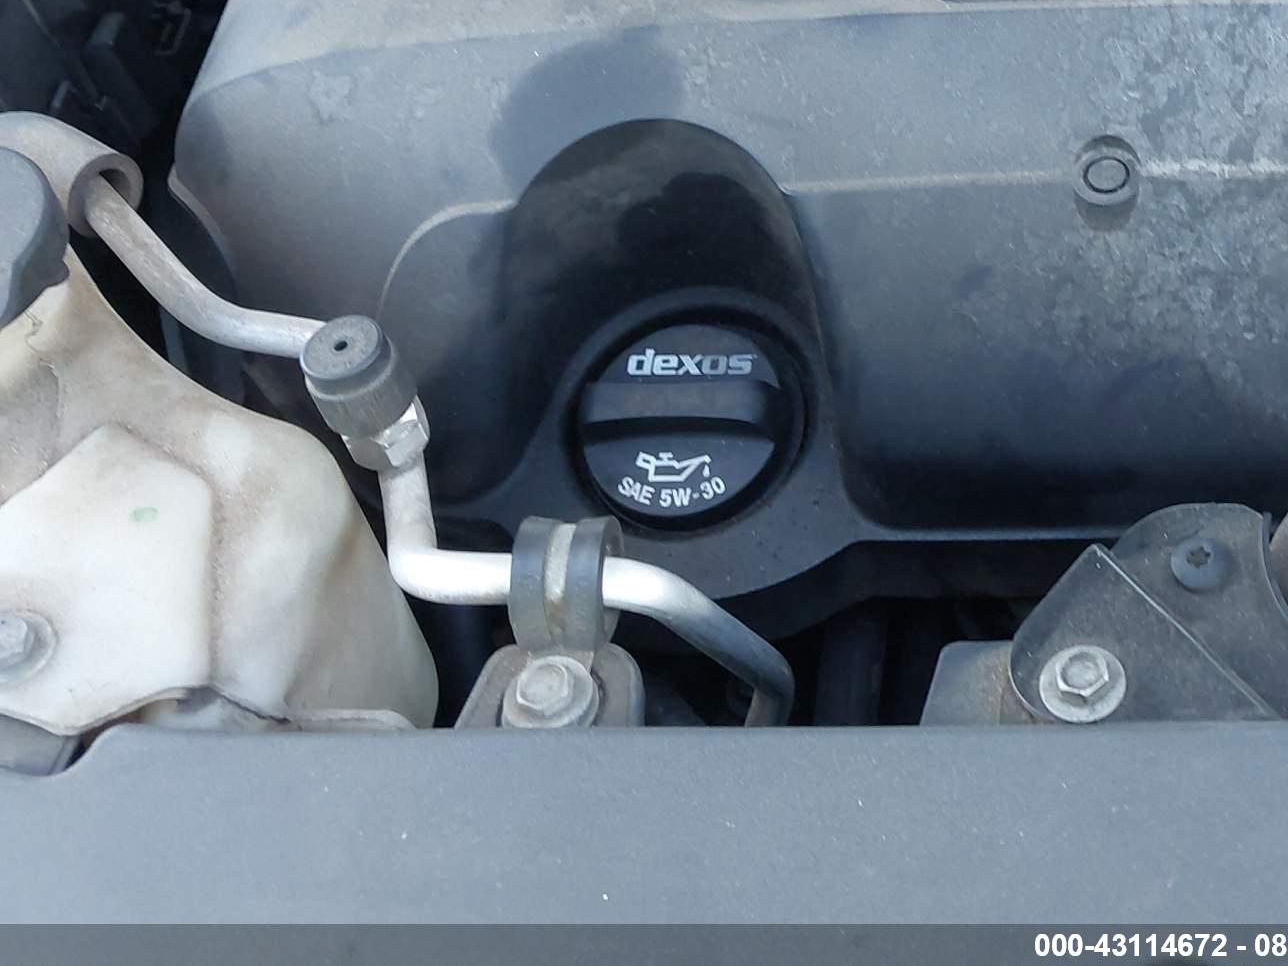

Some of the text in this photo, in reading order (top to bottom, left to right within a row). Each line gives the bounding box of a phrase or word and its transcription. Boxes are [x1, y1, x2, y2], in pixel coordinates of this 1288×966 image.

[626, 348, 754, 376] dexos
[617, 476, 727, 508] SAE 5W-30
